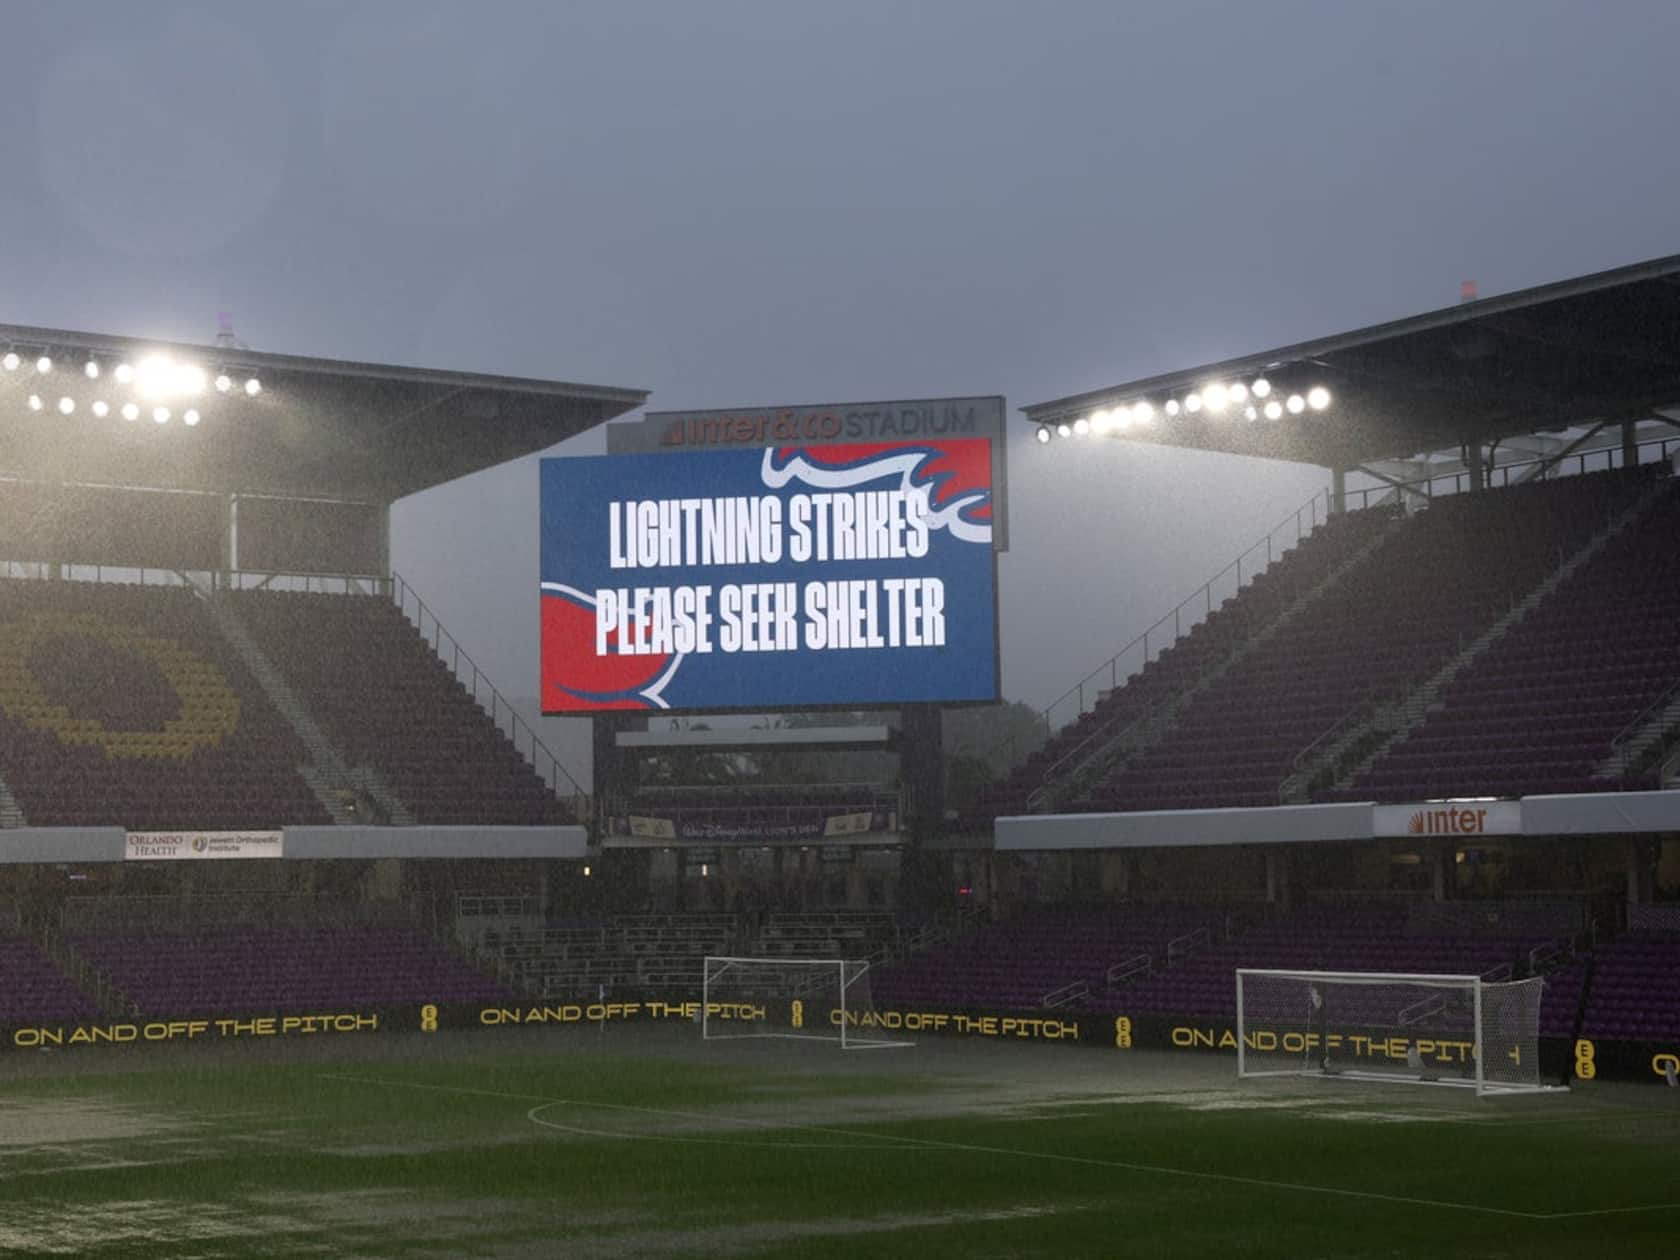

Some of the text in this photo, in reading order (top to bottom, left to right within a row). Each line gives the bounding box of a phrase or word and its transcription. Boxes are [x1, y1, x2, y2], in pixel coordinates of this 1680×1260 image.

[845, 405, 976, 438] STADIUM
[609, 487, 929, 568] LIGHTNING STRIKES
[595, 577, 945, 656] PLEASE SEEK SHELTER
[1428, 807, 1487, 833] inter
[480, 1001, 766, 1025] ON AND OFF THE PITCH
[830, 1009, 1079, 1039] ON AND OFF THE PITCH
[14, 1013, 379, 1046] ON AND OFF THE PITCH
[1171, 1027, 1215, 1047] ON
[1348, 1035, 1410, 1059] THE
